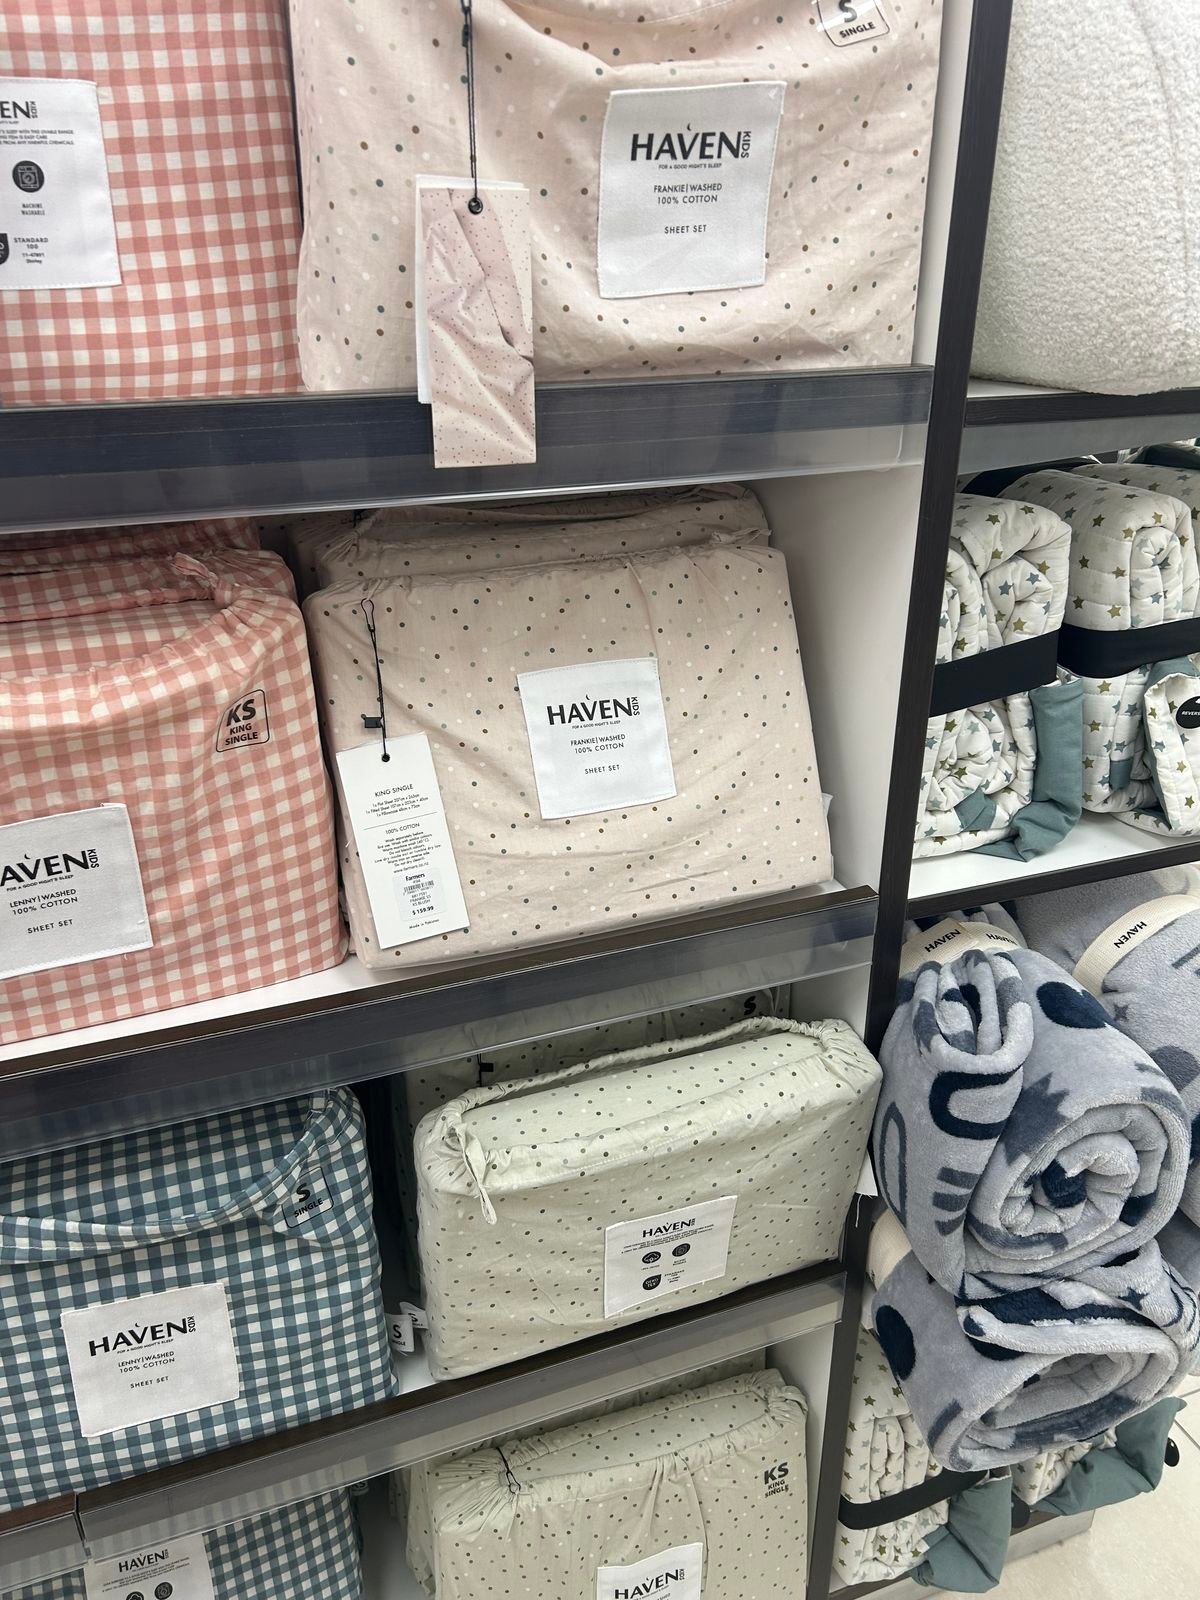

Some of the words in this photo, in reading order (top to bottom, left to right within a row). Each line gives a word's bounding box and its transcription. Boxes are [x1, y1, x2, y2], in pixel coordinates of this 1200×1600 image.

[839, 0, 857, 23] S
[839, 21, 876, 38] SINGLE
[631, 131, 741, 161] HAVEN
[741, 131, 752, 158] KIDS
[657, 196, 680, 205] 100%
[682, 195, 718, 204] COTTON
[664, 226, 690, 234] SHEET
[693, 224, 708, 233] SET
[226, 698, 256, 727] KS
[547, 697, 632, 725] HAVEN
[631, 696, 640, 716] KIDS
[225, 731, 259, 746] SINGLE
[230, 723, 252, 736] KING
[595, 742, 624, 751] COTTON
[585, 766, 605, 775] SHEET
[608, 764, 620, 772] SET
[86, 848, 99, 869] KIDS
[13, 906, 37, 915] 100%
[40, 897, 78, 909] COTTON
[27, 922, 54, 934] SHEET
[58, 919, 73, 927] SET
[1113, 921, 1147, 949] HAVEN
[924, 929, 961, 953] HAVEN
[744, 995, 756, 1016] S
[296, 1183, 310, 1202] S
[294, 1197, 324, 1218] SINGLE
[643, 1219, 692, 1238] HAVEN
[187, 1316, 196, 1333] KIDS
[393, 1324, 402, 1339] S
[89, 1318, 187, 1357] HAVEN
[120, 1365, 140, 1373] 100%
[143, 1357, 175, 1369] COTTON
[131, 1380, 153, 1389] SHEET
[156, 1376, 169, 1384] SET
[764, 1462, 789, 1485] KS
[765, 1484, 789, 1498] SINGLE
[768, 1479, 785, 1490] KING
[118, 1550, 165, 1572] HAVEN
[615, 1569, 678, 1599] HAVEN
